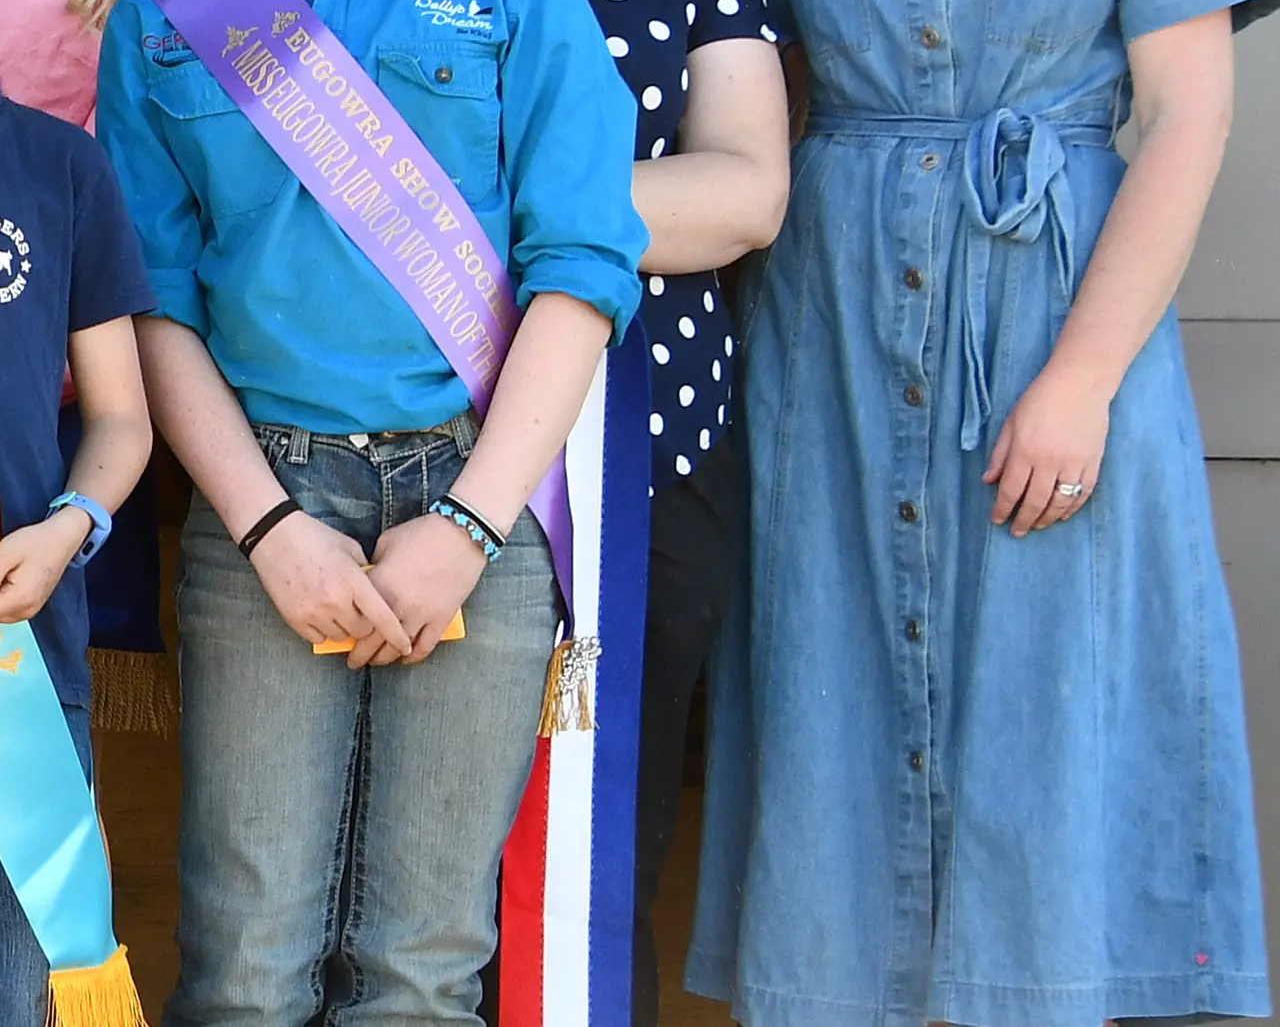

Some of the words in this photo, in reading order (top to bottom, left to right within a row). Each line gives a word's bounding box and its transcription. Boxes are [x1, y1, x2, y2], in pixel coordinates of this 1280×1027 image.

[421, 10, 493, 30] Dream
[231, 38, 286, 96] MISS
[262, 76, 358, 191] EUGOWRA
[284, 26, 395, 159] EUGOWRA
[390, 157, 460, 232] SHOW
[453, 240, 506, 332] SOCIE
[330, 168, 412, 247] JUNIOR
[393, 229, 470, 324] WOMAN
[450, 315, 487, 346] OF
[468, 338, 500, 391] TH
